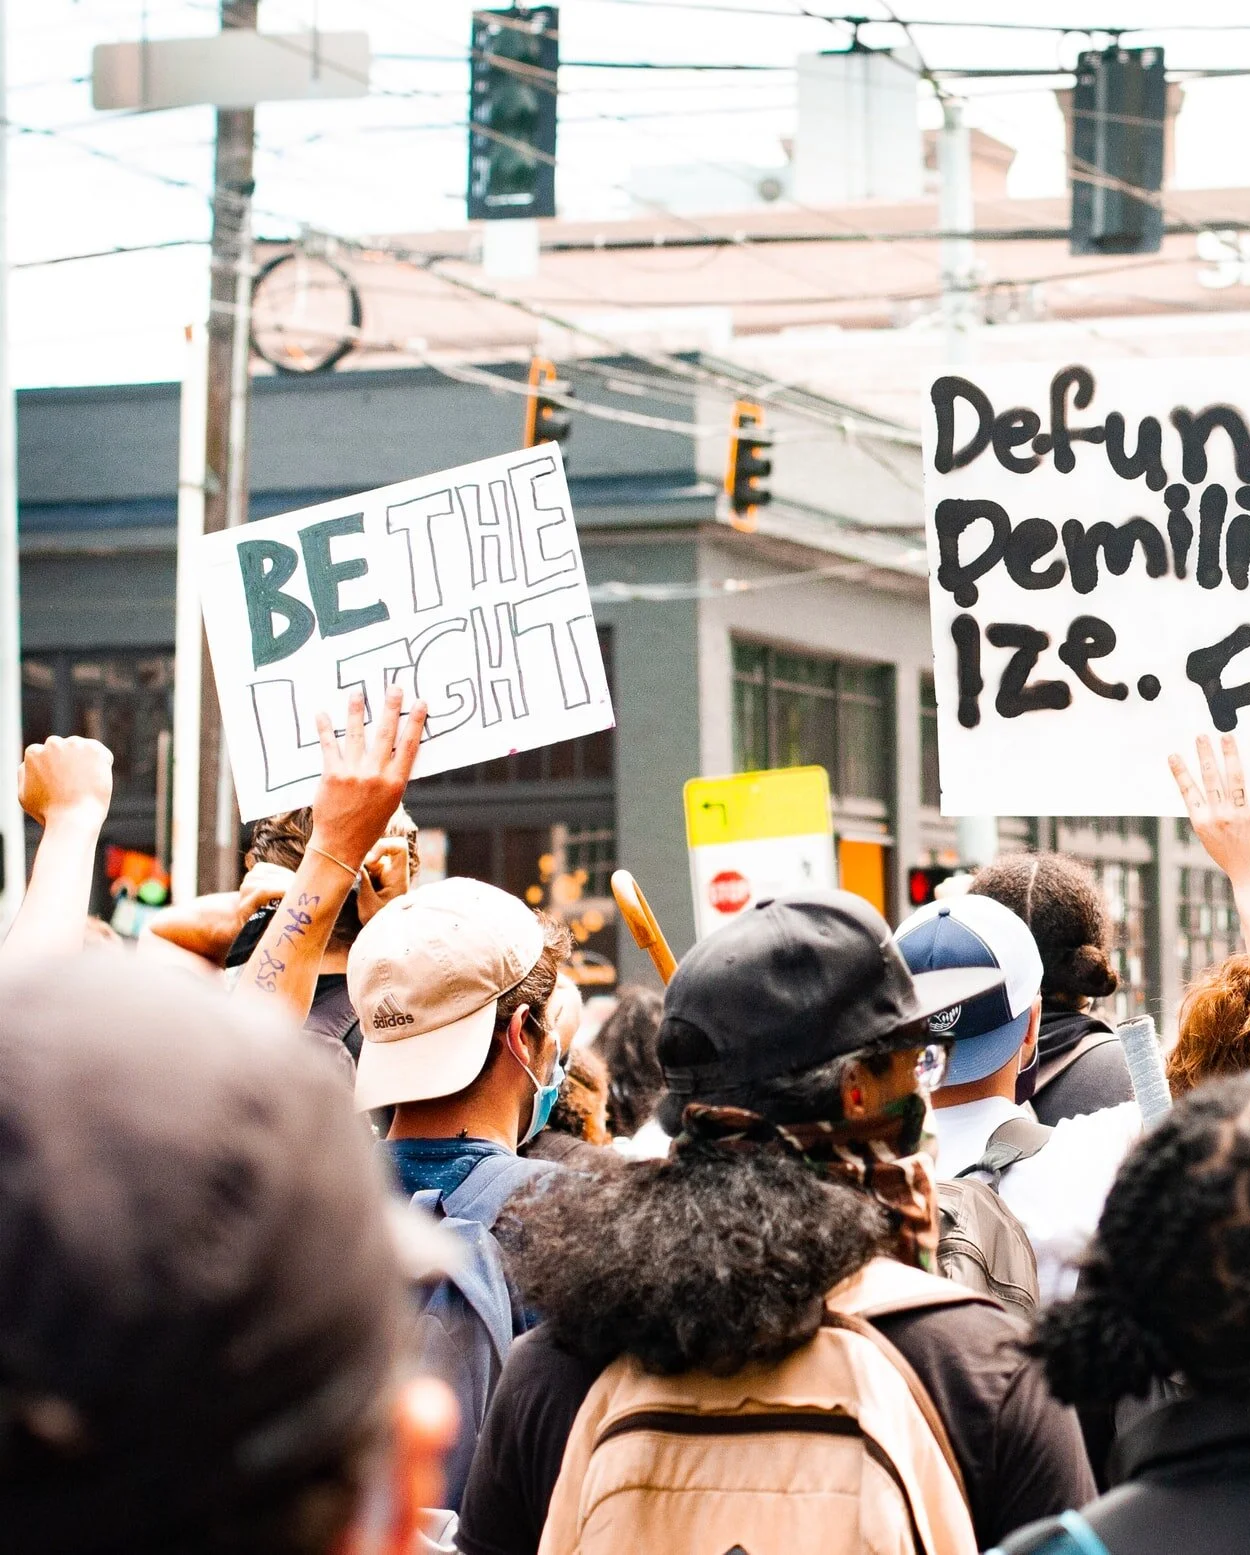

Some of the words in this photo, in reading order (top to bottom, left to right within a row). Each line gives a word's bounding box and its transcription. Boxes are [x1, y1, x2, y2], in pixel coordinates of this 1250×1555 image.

[237, 512, 390, 671] BE
[386, 456, 578, 612] THE
[246, 583, 592, 792] LIGHT
[373, 1013, 414, 1029] adidas
